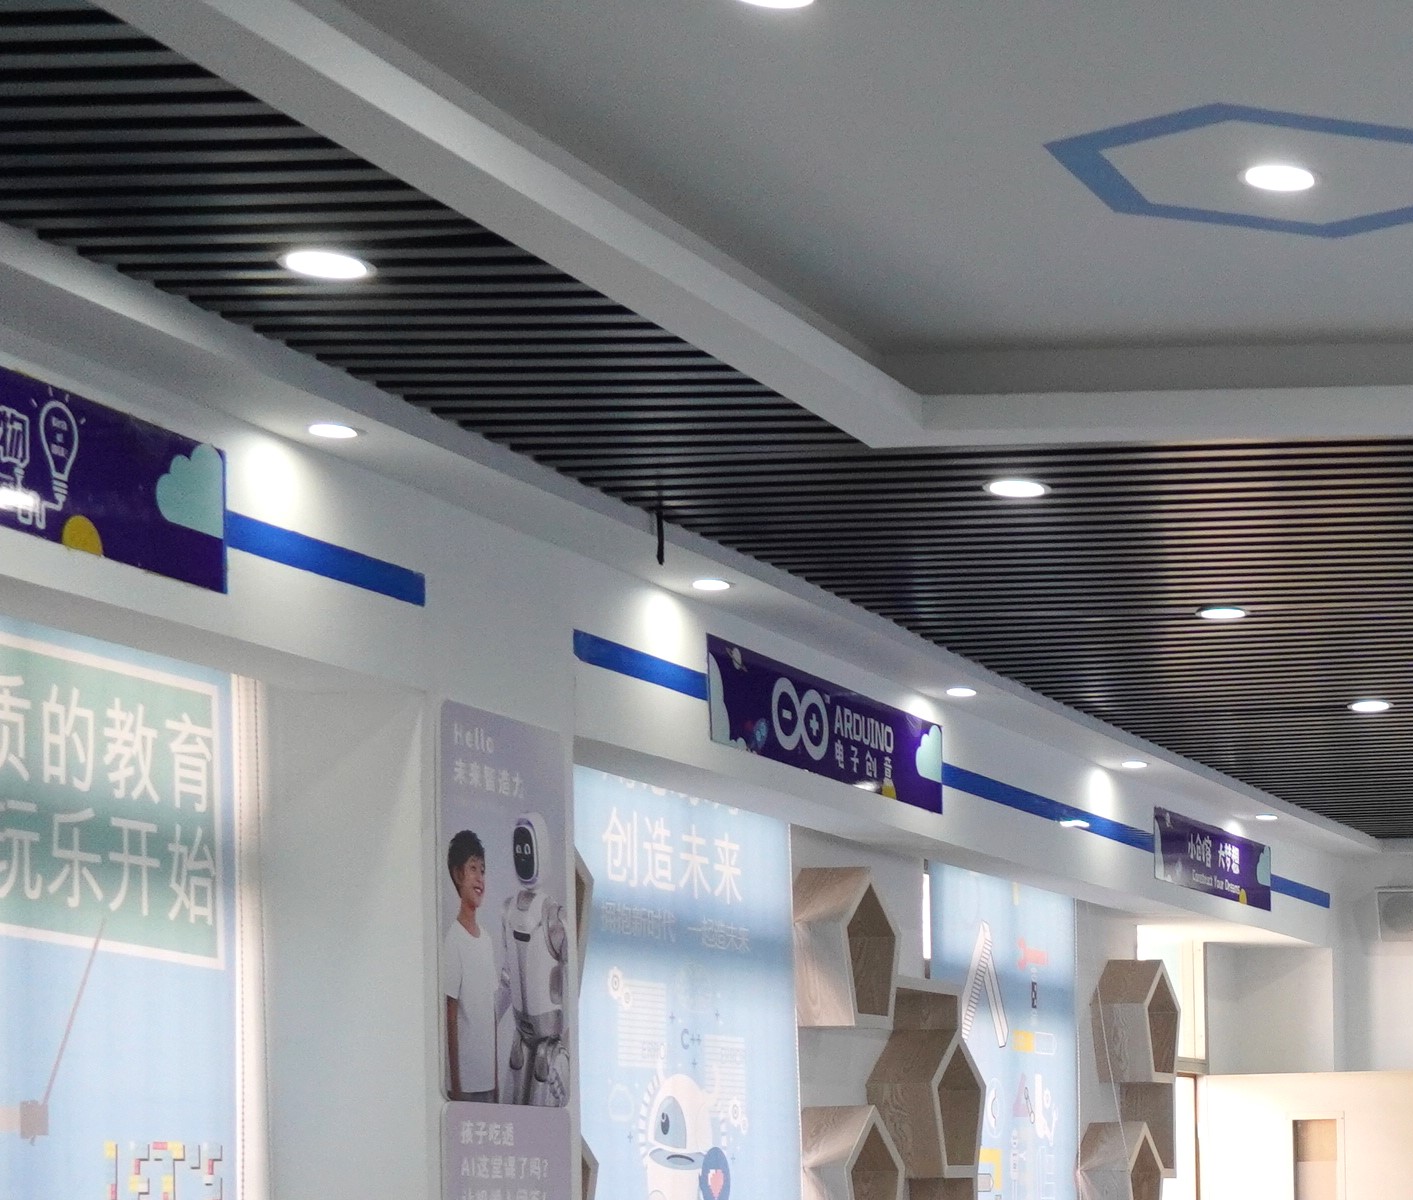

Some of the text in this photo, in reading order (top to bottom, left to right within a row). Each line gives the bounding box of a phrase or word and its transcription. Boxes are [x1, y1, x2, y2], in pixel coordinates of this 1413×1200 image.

[454, 722, 495, 753] Hello
[834, 705, 894, 754] ARDUINO
[0, 799, 216, 926] 玩乐开始
[602, 806, 742, 905] 创造未来
[1218, 842, 1240, 875] 大梦想
[681, 1028, 702, 1050] C++
